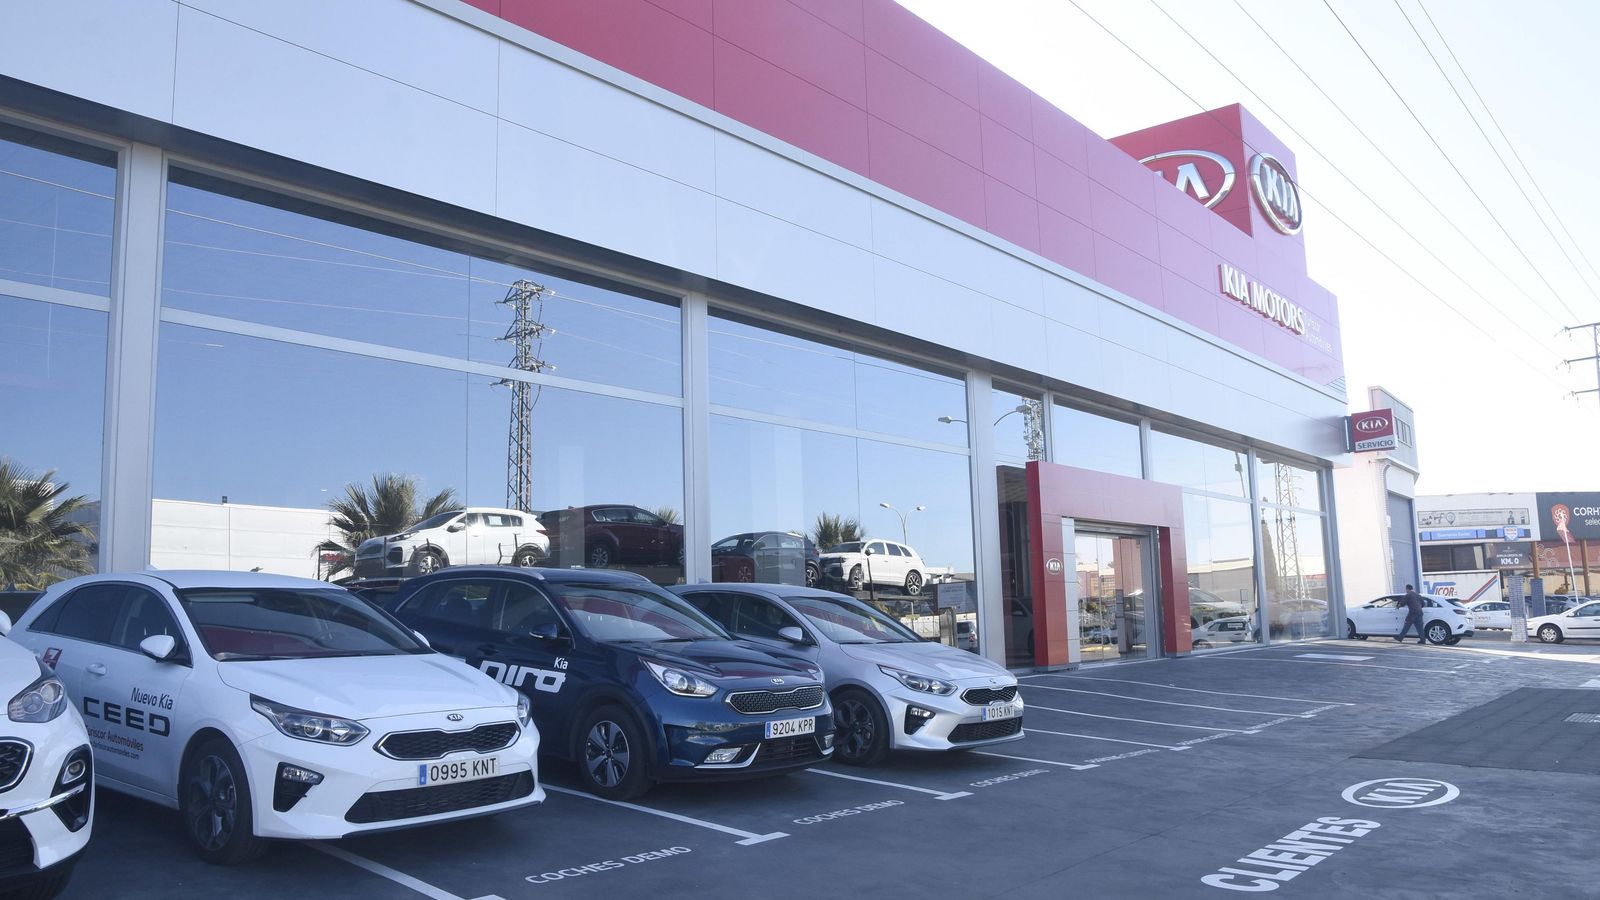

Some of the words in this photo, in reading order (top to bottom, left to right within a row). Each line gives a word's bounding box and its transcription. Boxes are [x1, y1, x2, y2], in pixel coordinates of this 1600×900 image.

[1261, 162, 1299, 224] KIA
[1219, 263, 1251, 305] KIA
[1251, 282, 1306, 335] MOTORS
[1361, 419, 1382, 430] KIA
[1357, 439, 1394, 450] SERVICIO
[1049, 561, 1061, 571] KIA
[553, 656, 569, 670] Kia
[478, 659, 567, 693] niro
[130, 687, 157, 708] Nuevo
[157, 693, 174, 711] Kia
[82, 696, 171, 738] CEED
[987, 706, 1003, 718] 1015
[1003, 705, 1013, 716] KNT
[772, 720, 796, 736] 9204
[797, 719, 813, 733] KPR
[430, 761, 468, 782] 0995
[472, 757, 497, 777] KNT
[1358, 781, 1442, 804] KIA
[792, 808, 862, 825] COCHES
[857, 799, 905, 812] DEMO
[524, 859, 625, 884] COCHES
[621, 845, 692, 865] DEMO
[1200, 815, 1382, 892] CLIENTES
